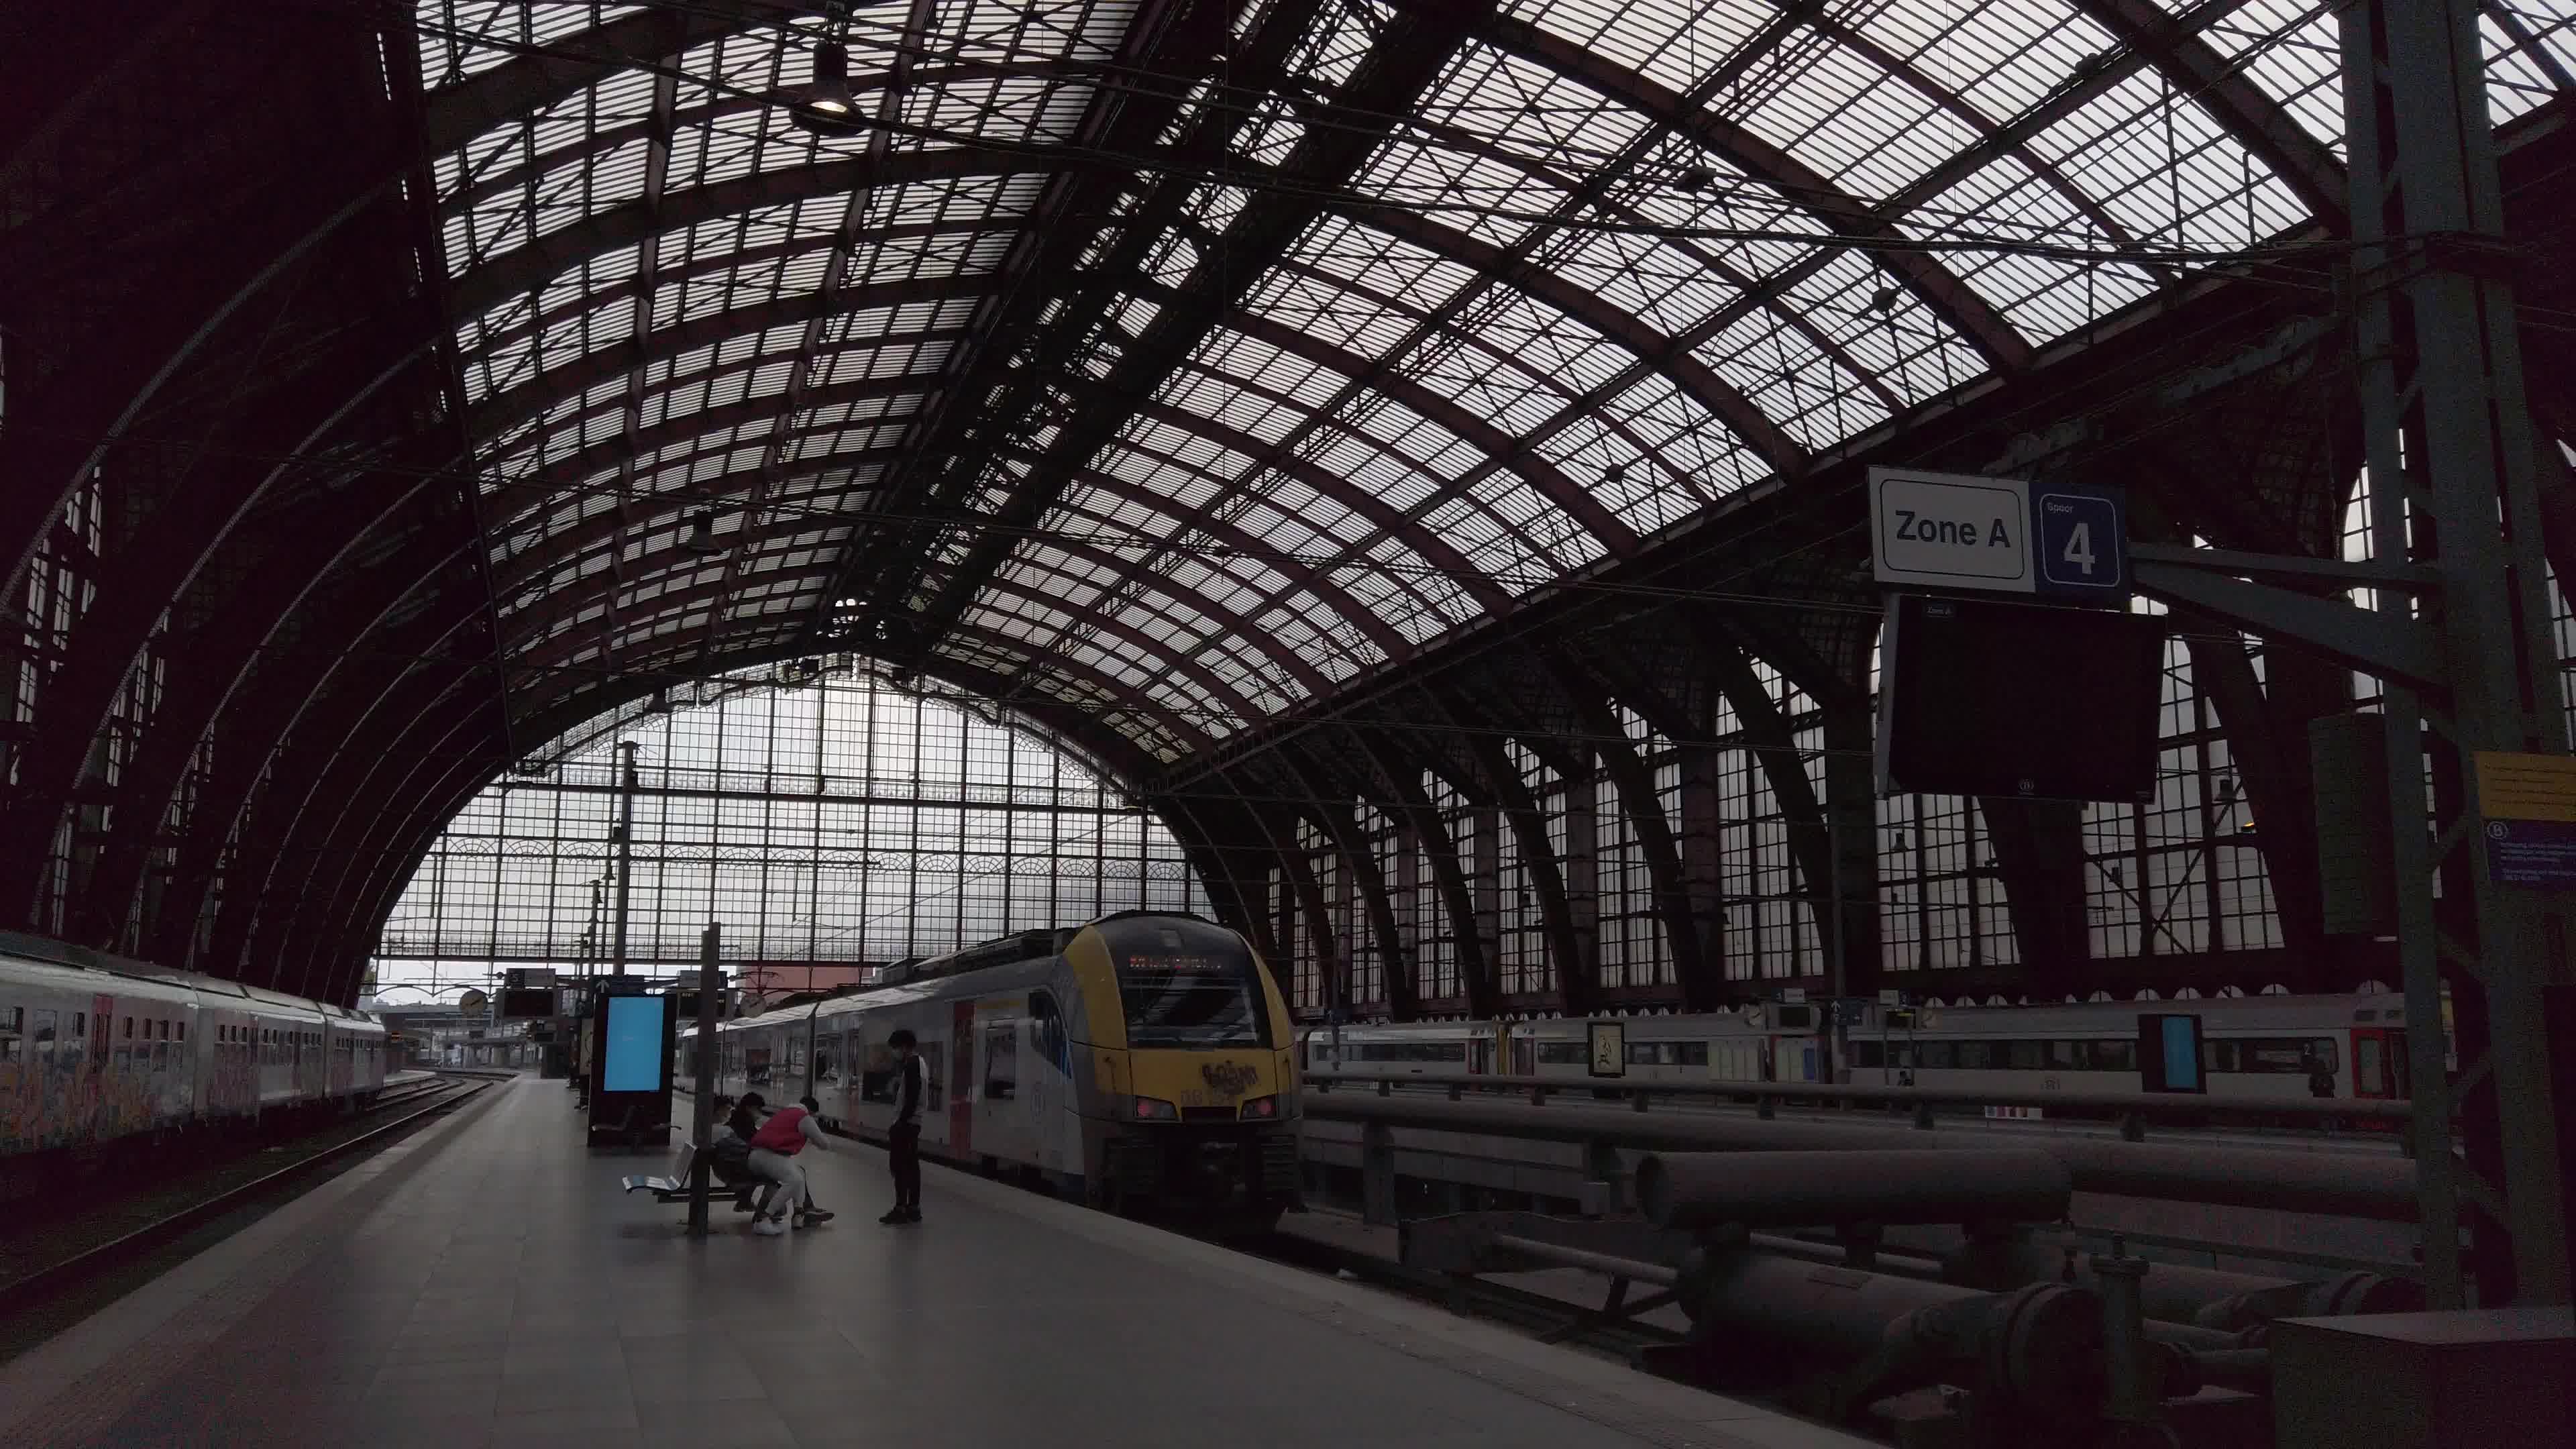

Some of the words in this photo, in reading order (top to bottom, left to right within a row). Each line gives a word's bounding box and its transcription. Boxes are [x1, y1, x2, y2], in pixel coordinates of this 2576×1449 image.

[1895, 510, 1977, 545] Zone
[1988, 519, 2011, 548] A
[2063, 522, 2096, 575] 4
